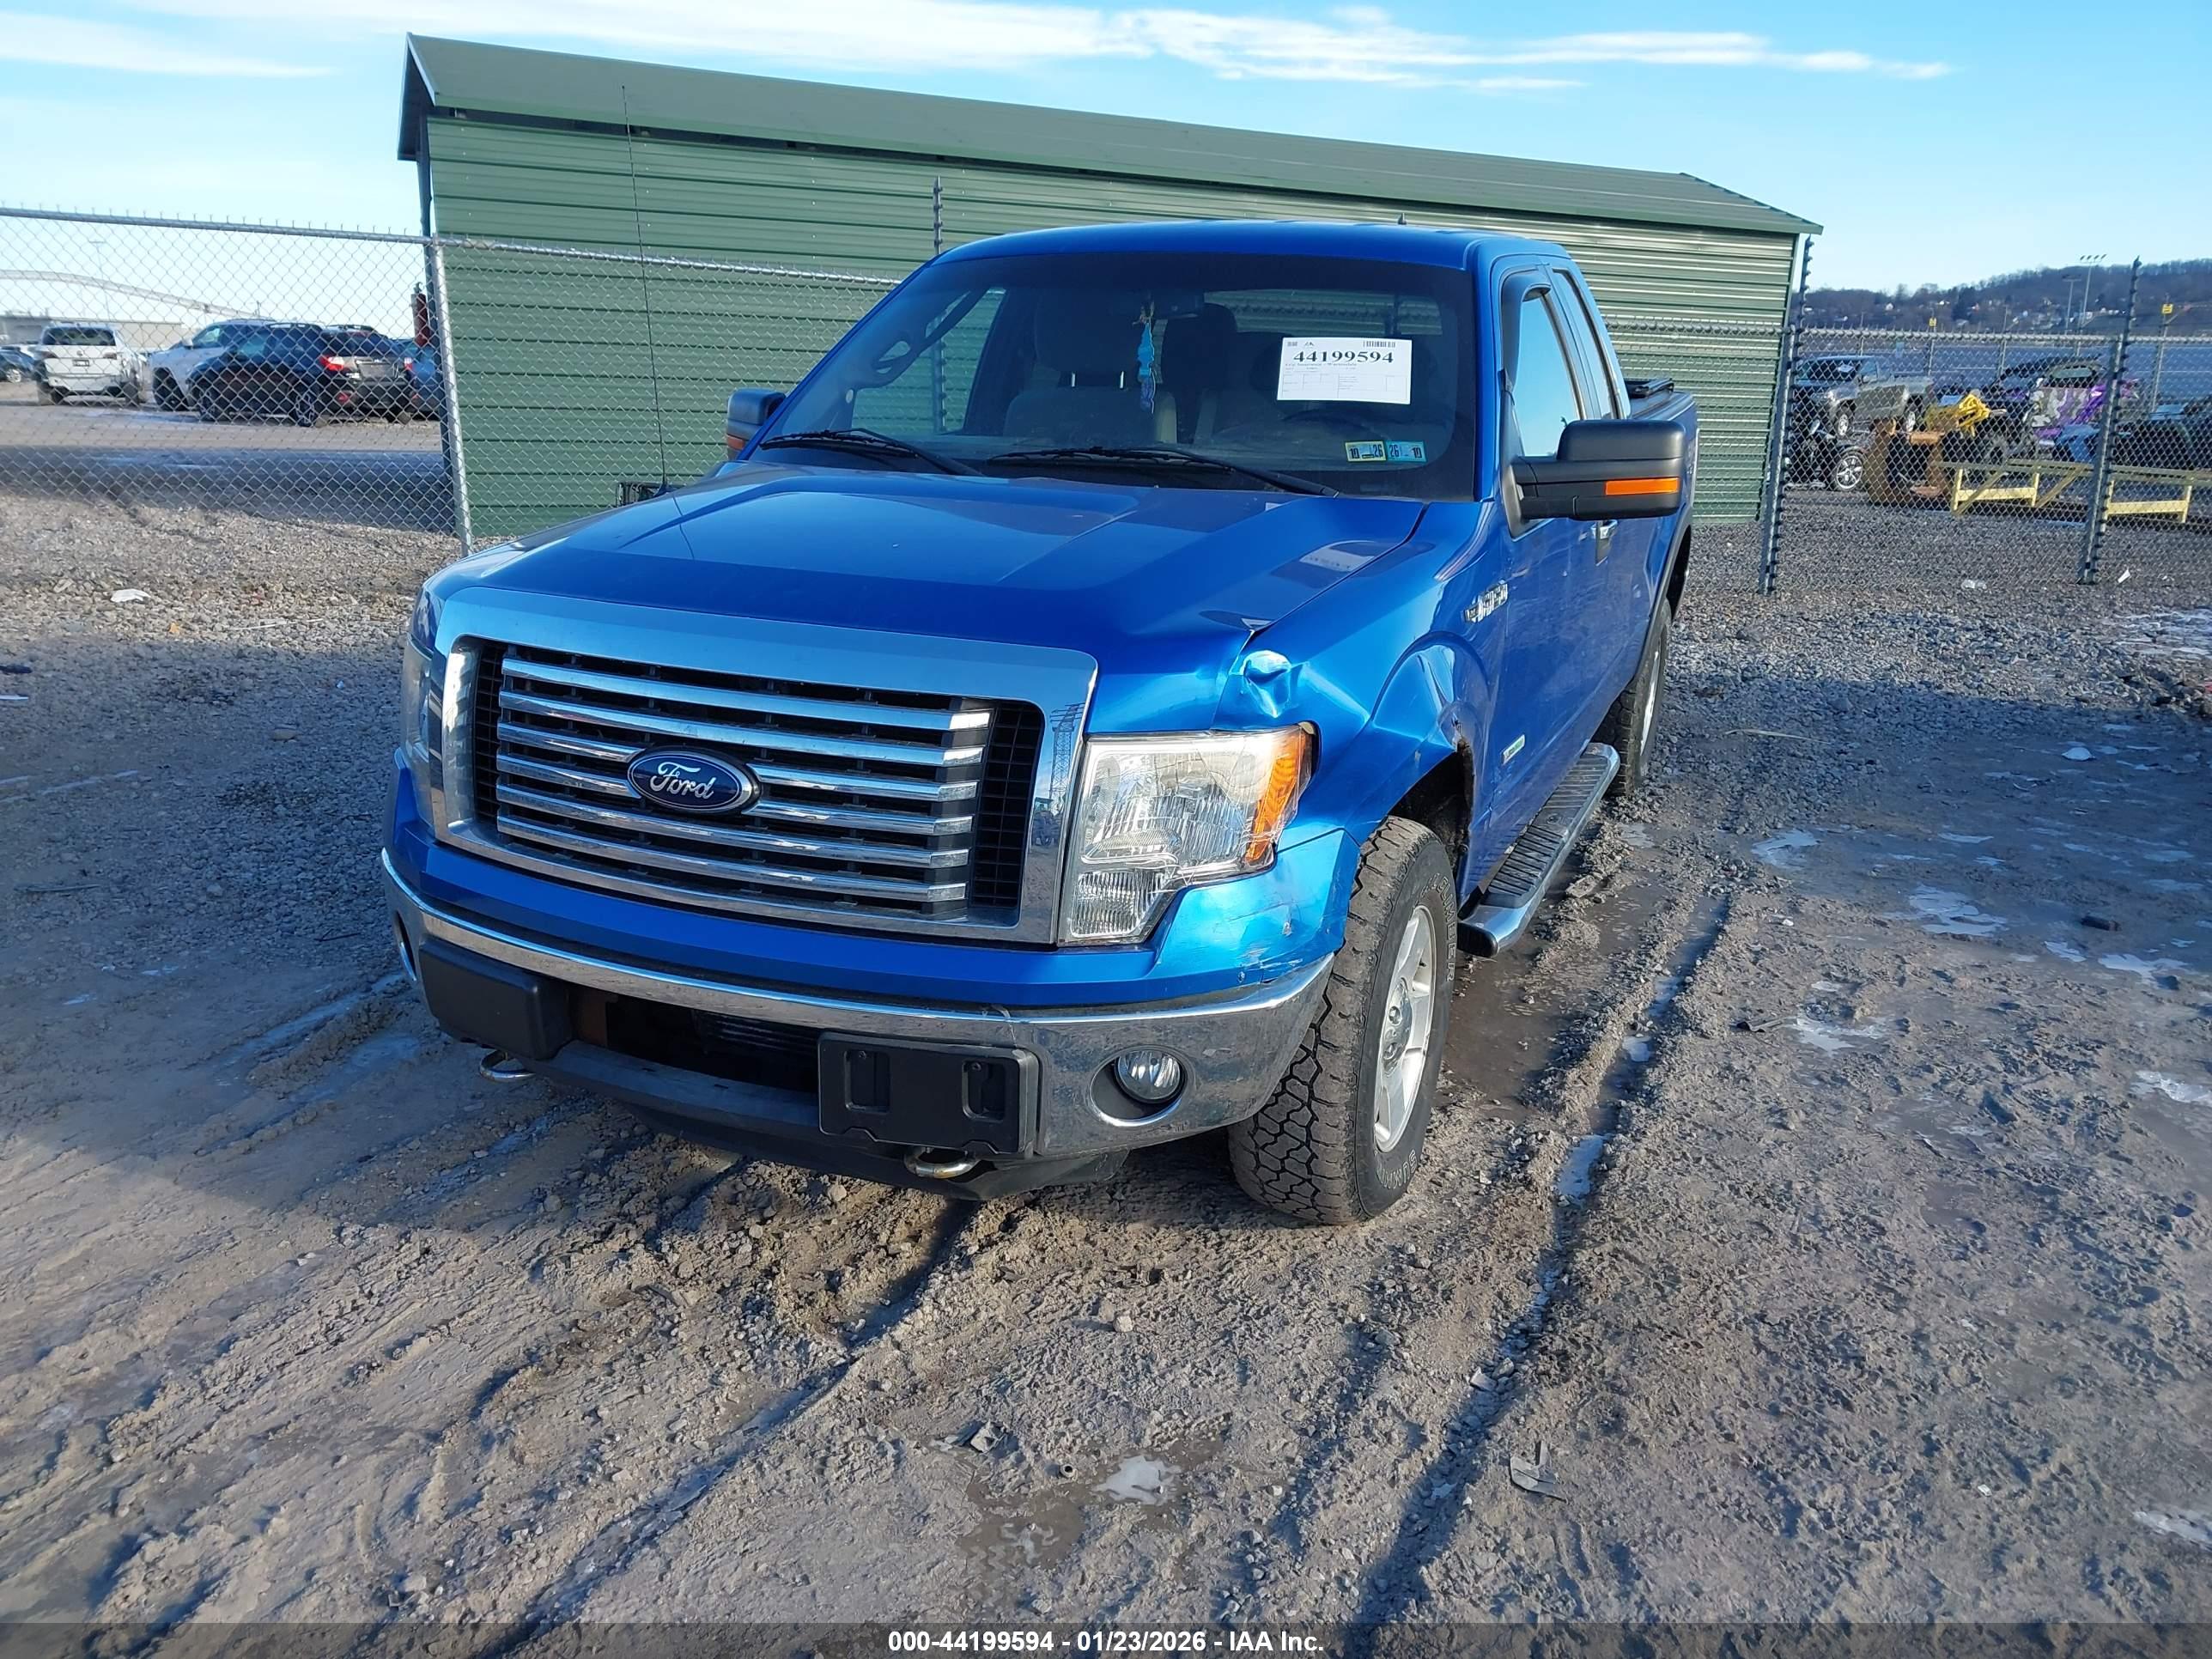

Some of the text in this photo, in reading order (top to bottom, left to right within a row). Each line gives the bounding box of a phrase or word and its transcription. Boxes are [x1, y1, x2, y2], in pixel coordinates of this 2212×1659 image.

[1293, 350, 1394, 363] 44199594
[1373, 444, 1383, 458] 26
[1389, 444, 1400, 458] 26
[649, 761, 717, 799] Ford
